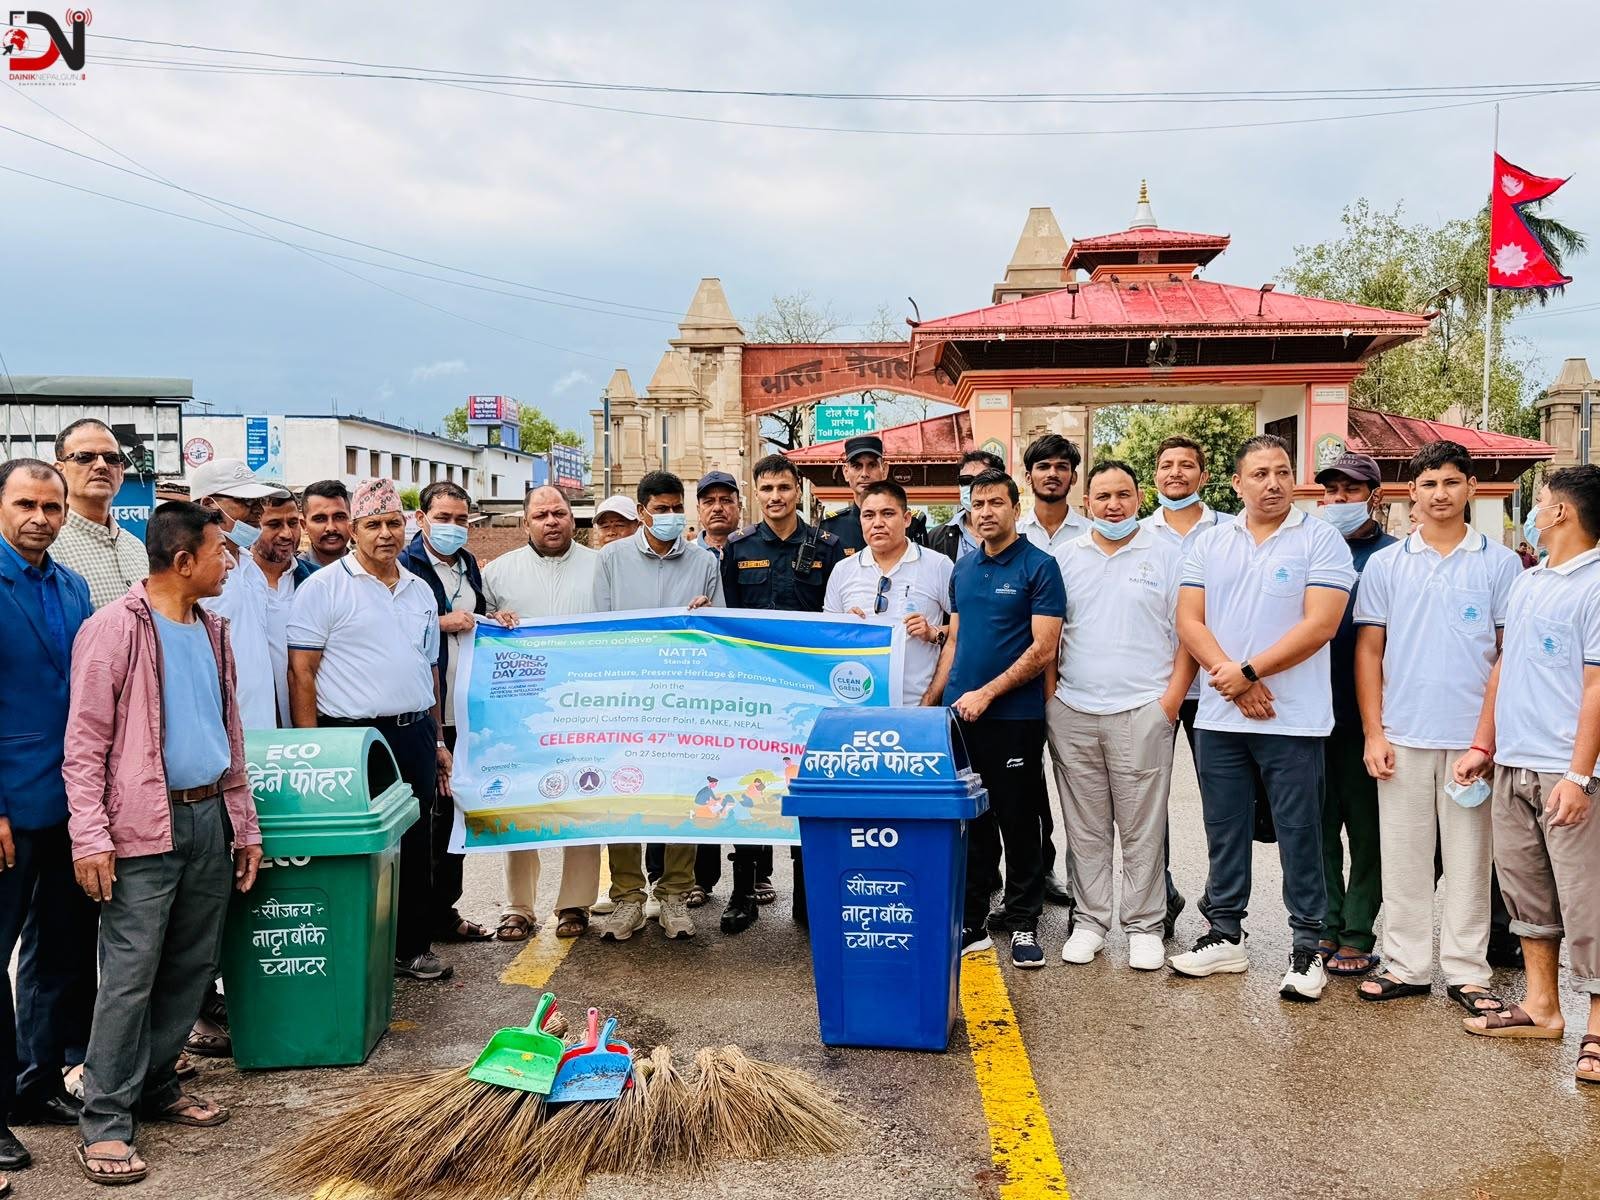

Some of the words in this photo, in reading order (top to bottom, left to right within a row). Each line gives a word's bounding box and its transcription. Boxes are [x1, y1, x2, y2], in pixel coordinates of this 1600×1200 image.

[760, 359, 823, 394] भारत
[825, 407, 842, 418] टोल
[818, 429, 833, 437] Toll
[834, 429, 855, 437] Road
[110, 505, 151, 523] ाउला
[570, 639, 585, 647] we
[495, 651, 546, 661] WORLD
[658, 648, 707, 657] NATTA
[492, 669, 516, 679] DAY
[518, 668, 546, 677] 2026
[494, 660, 548, 670] TOURISM
[604, 670, 639, 678] Nature,
[641, 669, 683, 677] Preserve
[684, 669, 727, 679] Heritage
[737, 672, 777, 683] Promote
[778, 679, 815, 690] Tourism
[649, 682, 669, 690] Join
[671, 682, 684, 690] the
[558, 692, 655, 712] Cleaning
[662, 693, 773, 716] Campaign
[553, 715, 600, 725] Nepalgunj
[601, 715, 639, 723] Customs
[642, 715, 670, 723] Border
[673, 716, 697, 725] Point,
[699, 718, 732, 727] BANKE,
[539, 732, 644, 747] CELEBRATING
[648, 732, 675, 744] 47th
[677, 733, 735, 749] WORLD
[853, 730, 899, 747] ECO
[266, 743, 321, 761] ECO
[651, 751, 699, 760] September
[700, 753, 720, 761] 2026
[882, 746, 947, 777] फोहर
[289, 761, 357, 802] फोहर
[851, 827, 899, 848] ECO
[846, 873, 907, 896] सौजन्य
